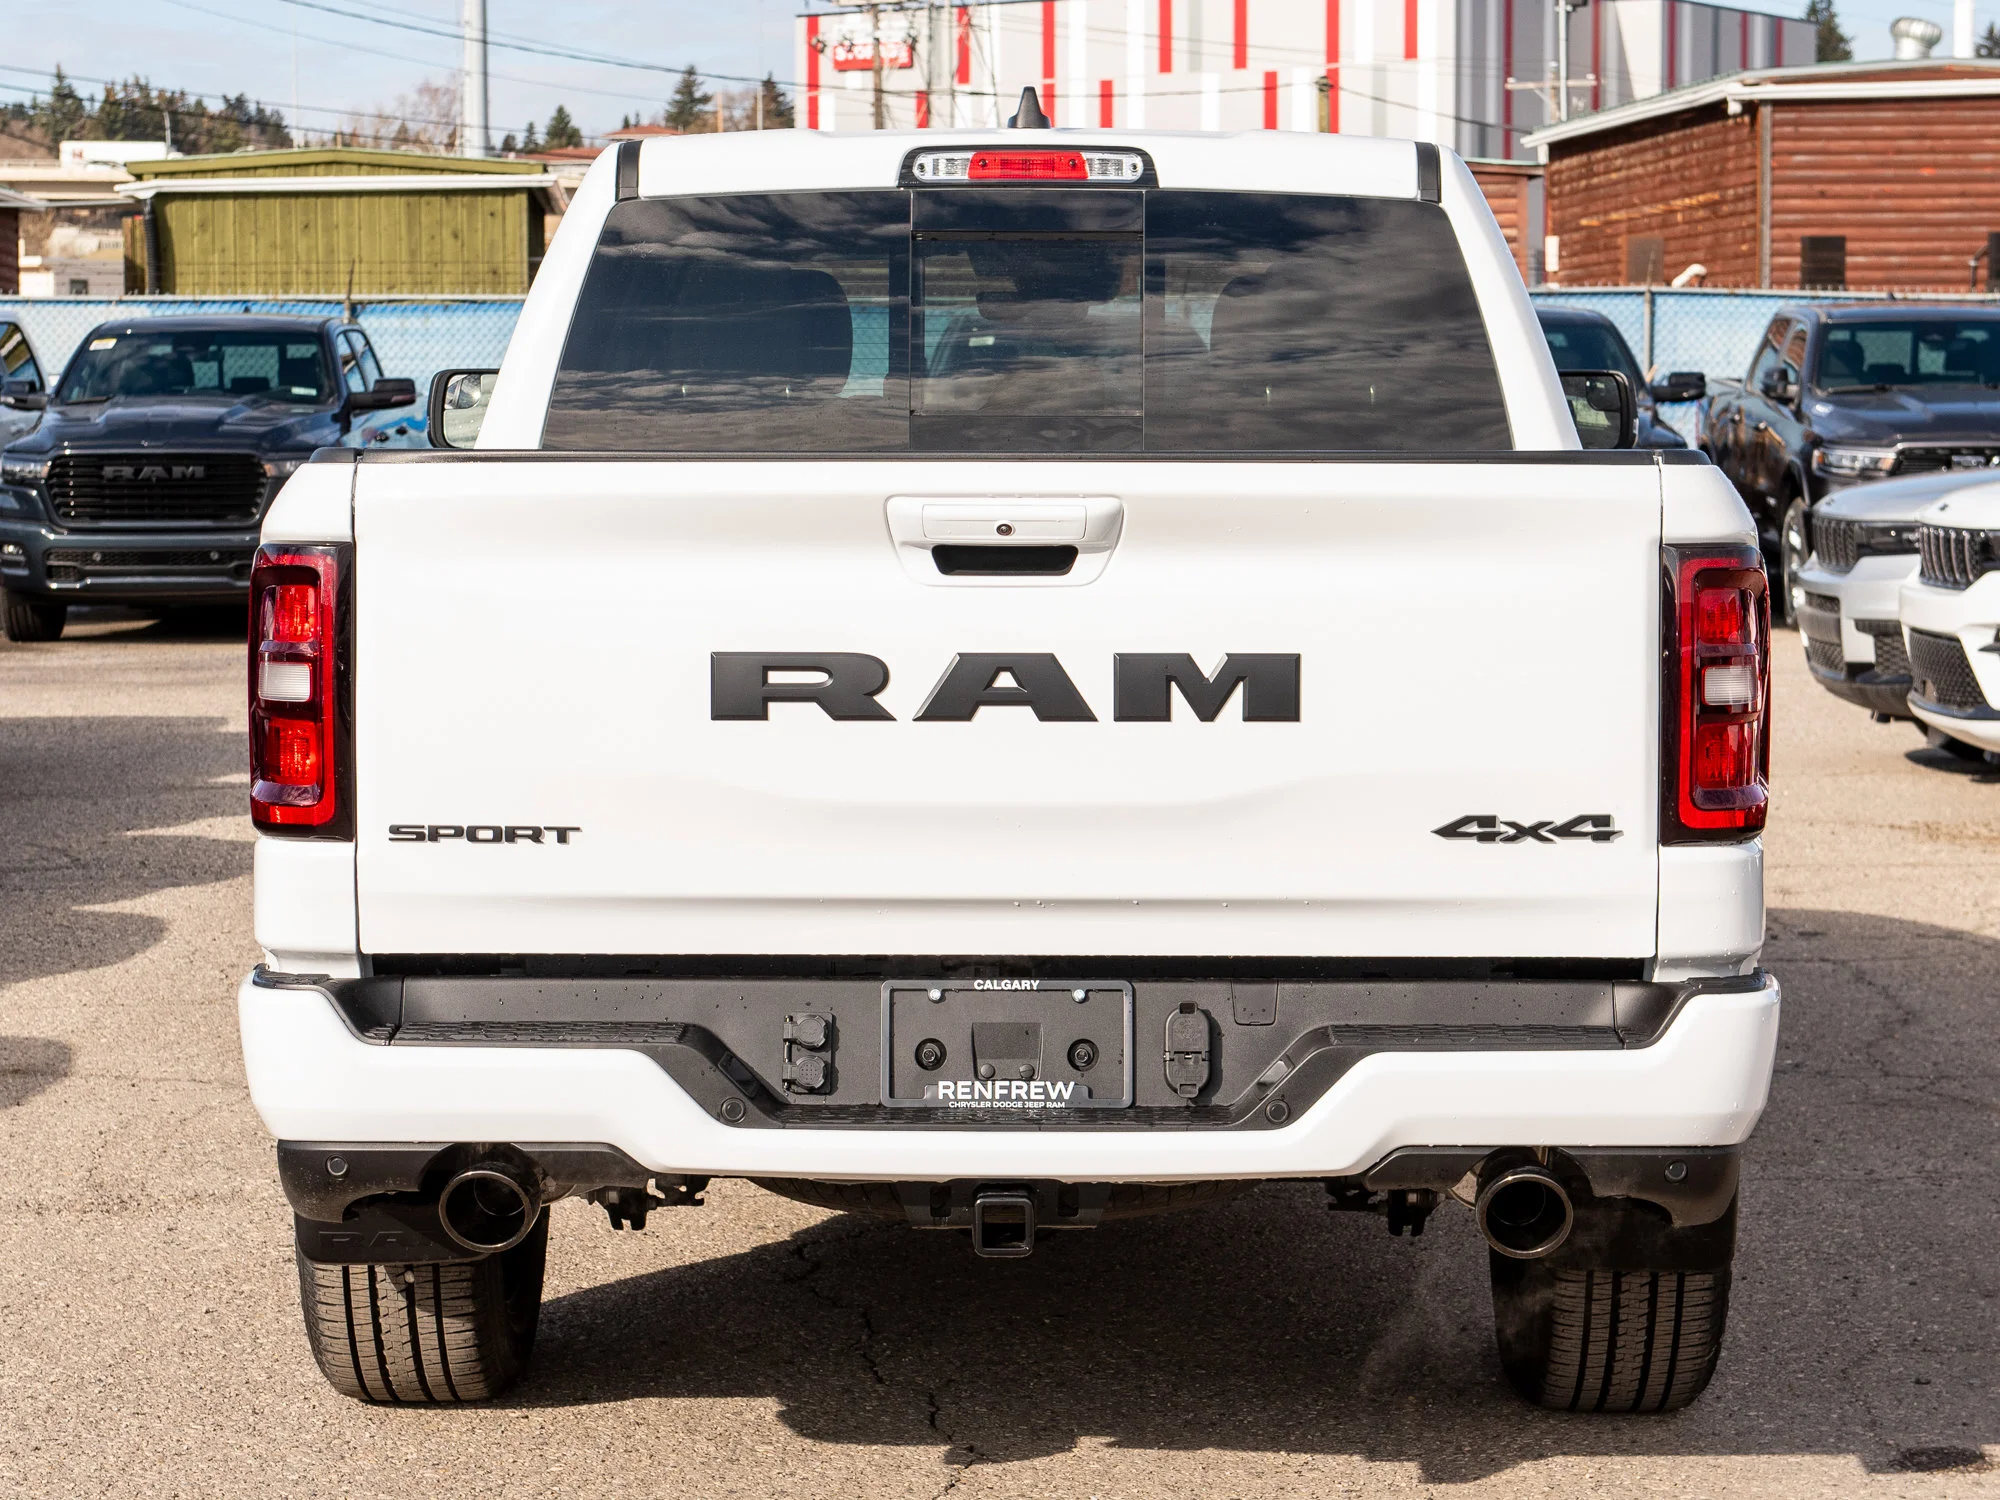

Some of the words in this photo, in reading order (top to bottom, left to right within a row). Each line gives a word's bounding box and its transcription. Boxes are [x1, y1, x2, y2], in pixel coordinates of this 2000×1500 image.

[102, 465, 205, 480] RAM
[710, 651, 1301, 722] RAM
[388, 824, 583, 844] SPORT
[1430, 814, 1624, 844] 4x4
[973, 979, 1040, 990] CALGARY
[938, 1080, 1075, 1100] RENFREW
